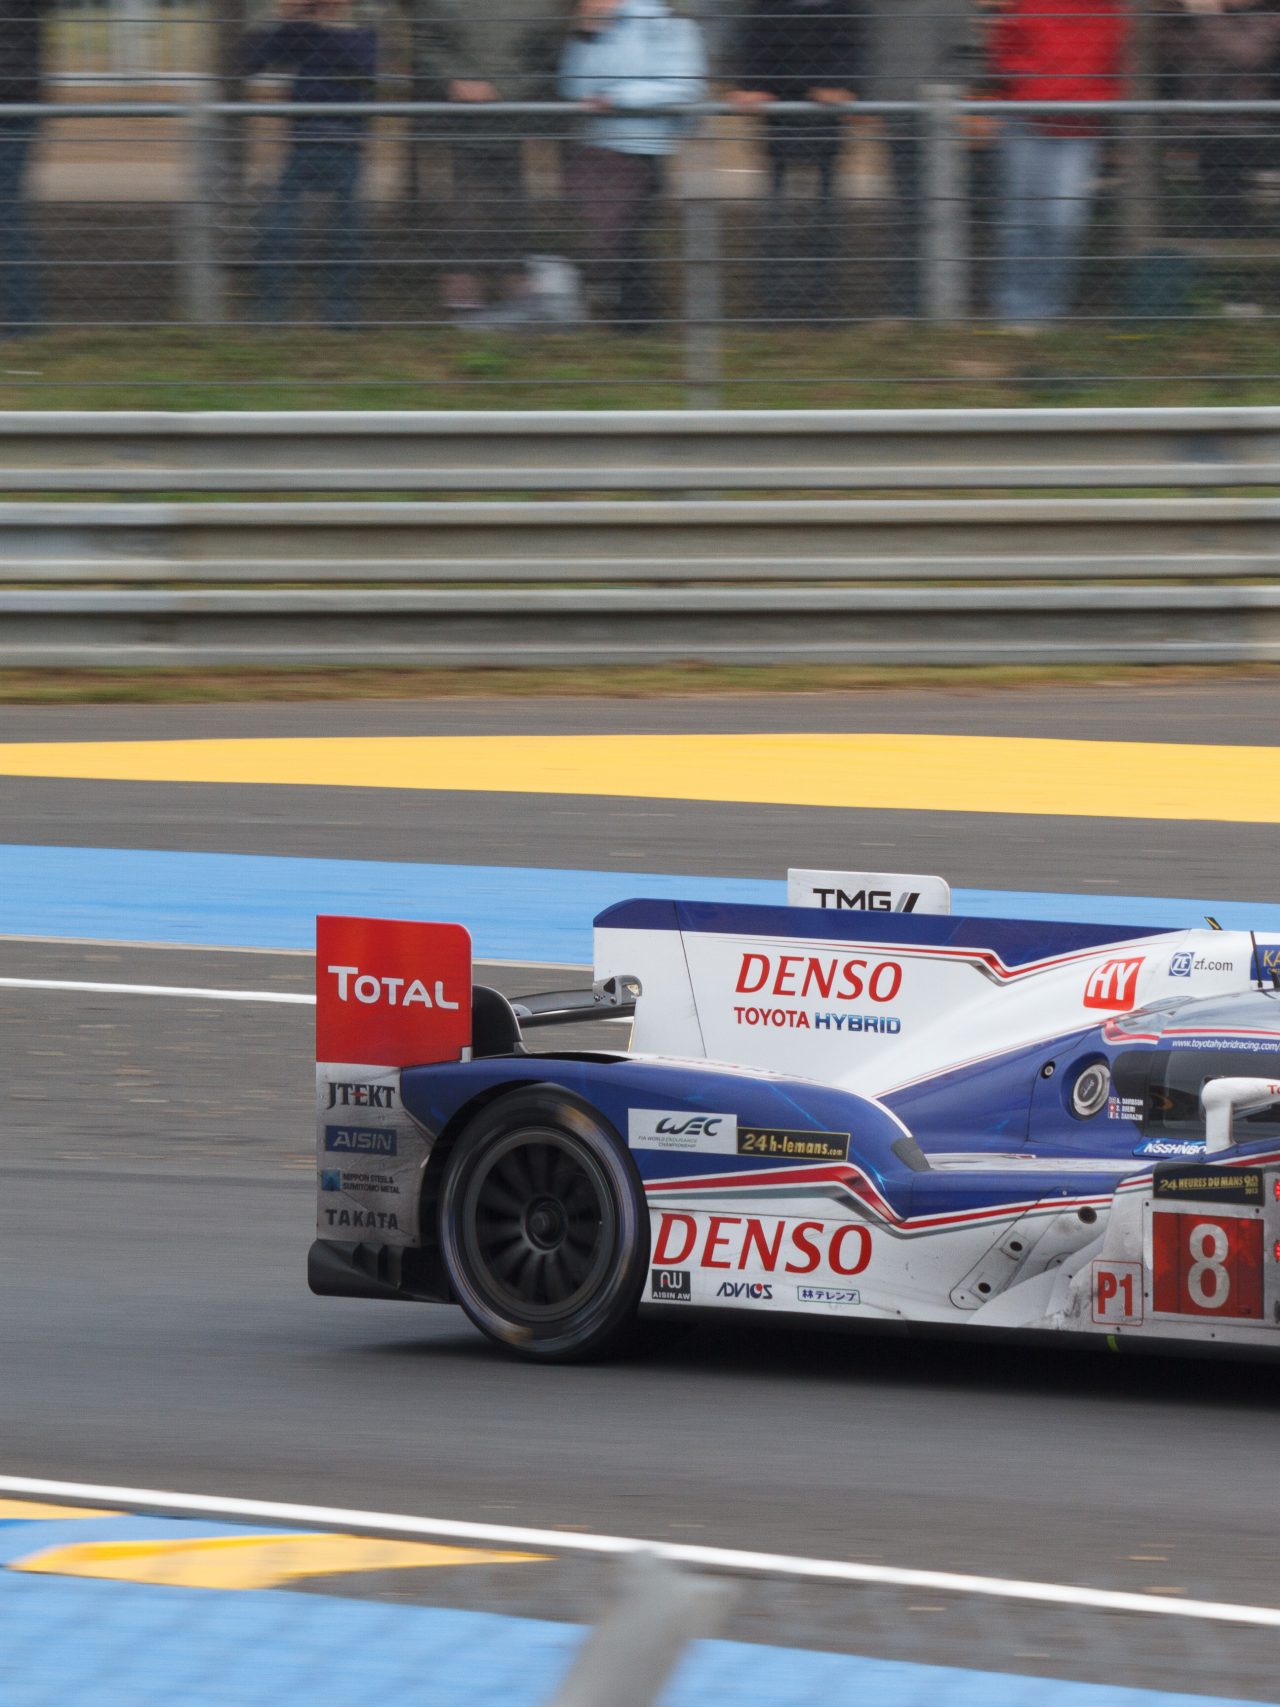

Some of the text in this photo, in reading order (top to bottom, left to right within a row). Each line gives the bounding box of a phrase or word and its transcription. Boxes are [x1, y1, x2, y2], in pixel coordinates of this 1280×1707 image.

[812, 888, 891, 912] TMG
[1194, 957, 1233, 972] zf.com
[327, 965, 460, 1010] TOTAL
[735, 953, 903, 1003] DENSO
[733, 1006, 902, 1035] TOYOTA HYBRID
[326, 1082, 396, 1110] JTEKT
[655, 1117, 723, 1136] WEC
[333, 1131, 392, 1151] AISIN
[1178, 1179, 1207, 1189] HEURES
[1208, 1178, 1219, 1187] DU
[1219, 1176, 1243, 1186] MANS
[325, 1209, 399, 1230] TAKATA
[652, 1213, 872, 1275] DENSO
[1187, 1223, 1230, 1309] 8
[652, 1291, 690, 1300] AISIN AW
[1097, 1271, 1133, 1317] P1
